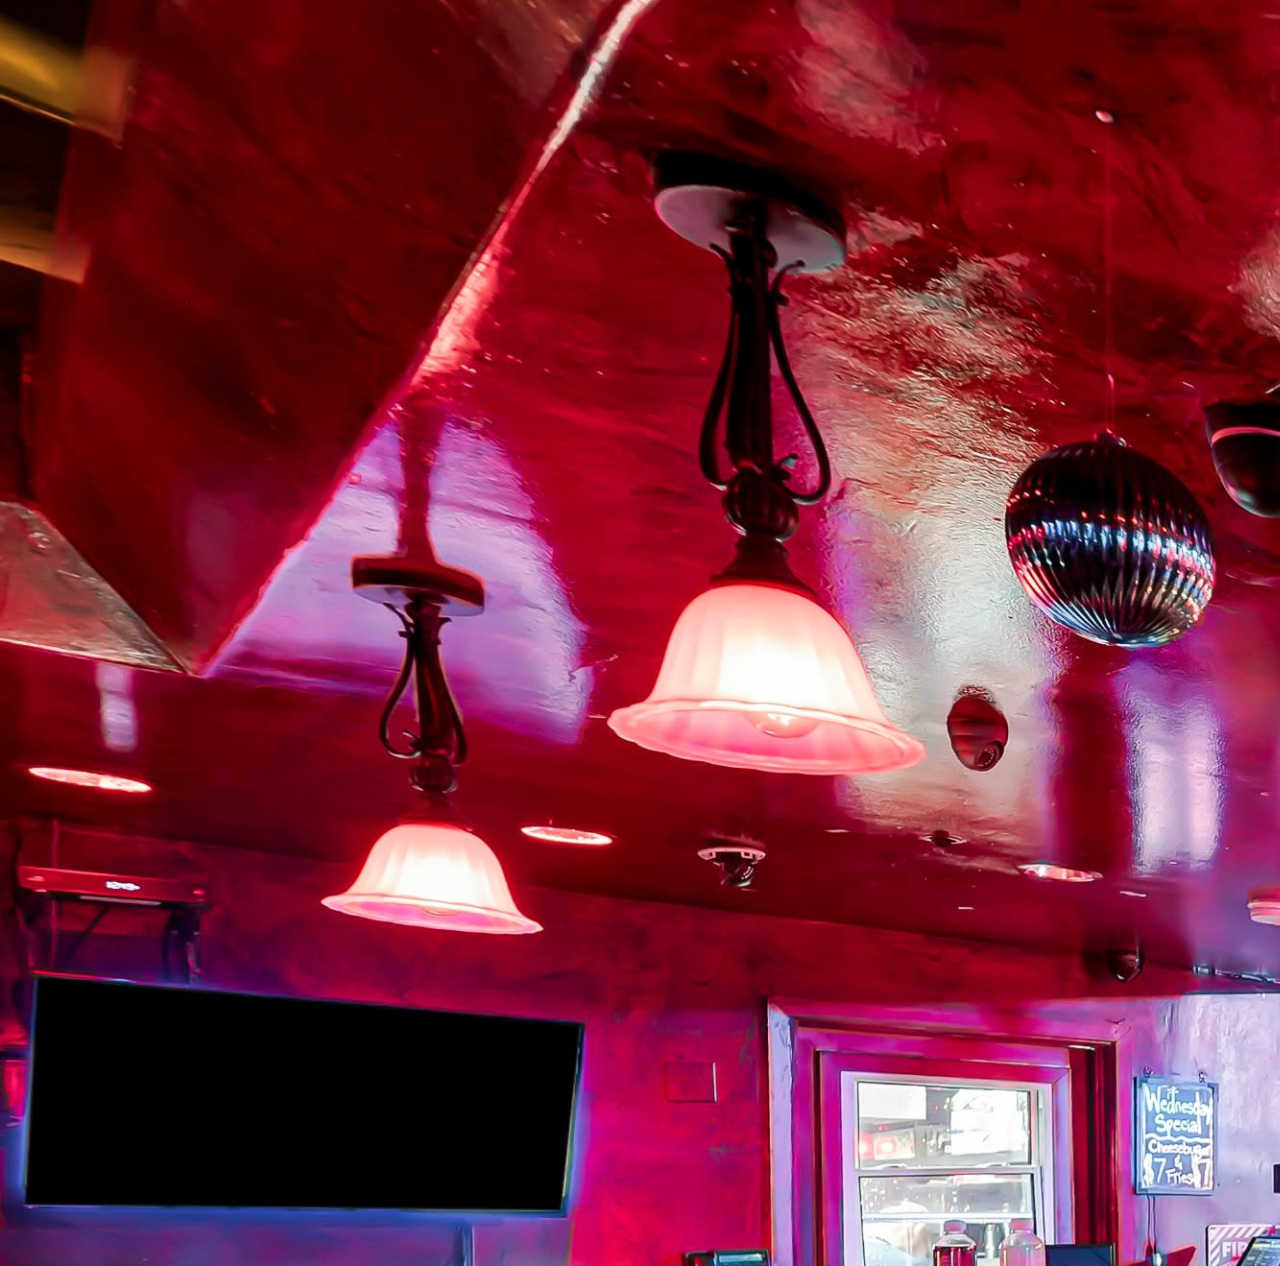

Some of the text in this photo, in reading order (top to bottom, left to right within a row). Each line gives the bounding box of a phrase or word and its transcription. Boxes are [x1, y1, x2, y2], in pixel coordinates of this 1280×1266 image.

[1142, 1083, 1212, 1126] Wednesday
[1155, 1114, 1201, 1137] Special
[1165, 1168, 1194, 1185] Fries
